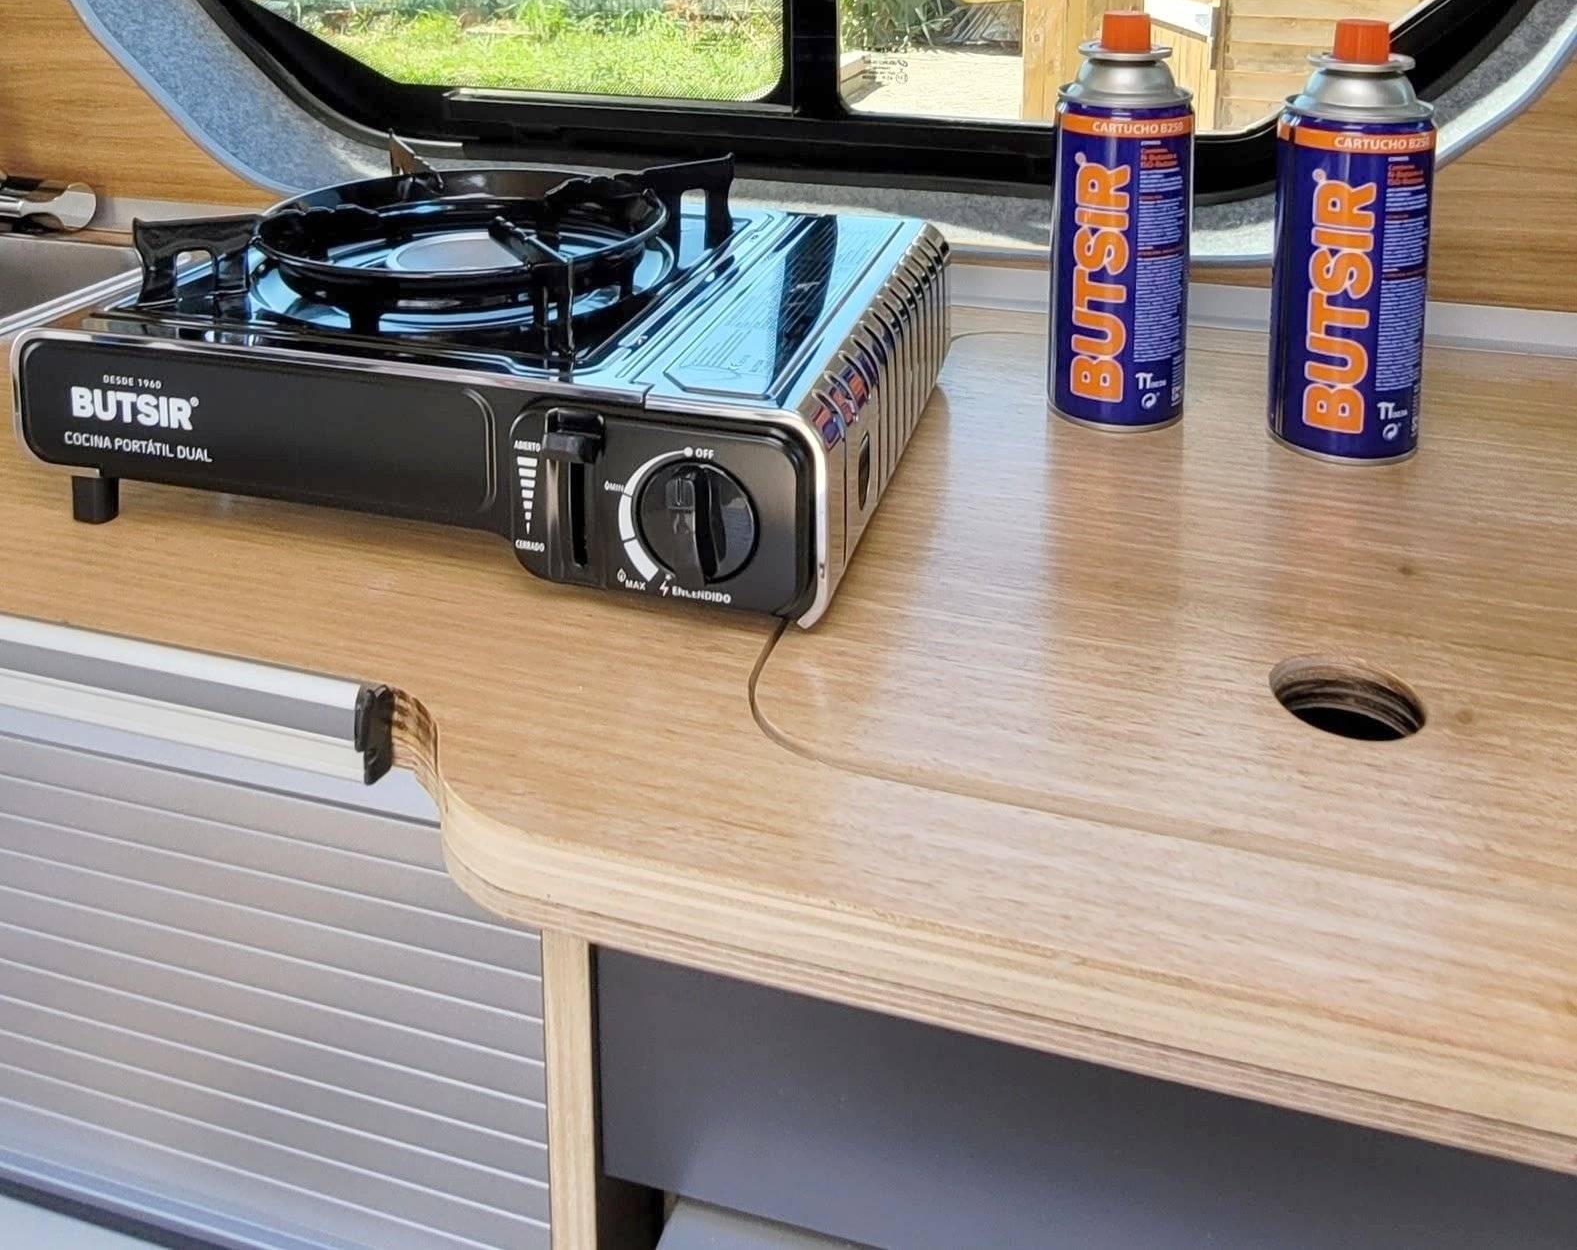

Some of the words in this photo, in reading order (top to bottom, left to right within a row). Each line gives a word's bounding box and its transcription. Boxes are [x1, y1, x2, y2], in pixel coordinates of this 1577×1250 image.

[1092, 121, 1159, 135] CARTUCHO
[1160, 120, 1184, 133] B250
[1334, 136, 1407, 150] CARTUCHO
[1069, 160, 1131, 404] BUTSIR
[1302, 179, 1377, 435] BUTSIR
[103, 374, 134, 387] DESDE
[137, 378, 162, 390] 1960
[70, 386, 194, 431] BUTSIR
[64, 431, 112, 449] COCINA
[114, 437, 175, 458] PORTÁTIL
[177, 444, 213, 463] DUAL
[694, 449, 715, 460] OFF
[625, 579, 647, 591] MAX
